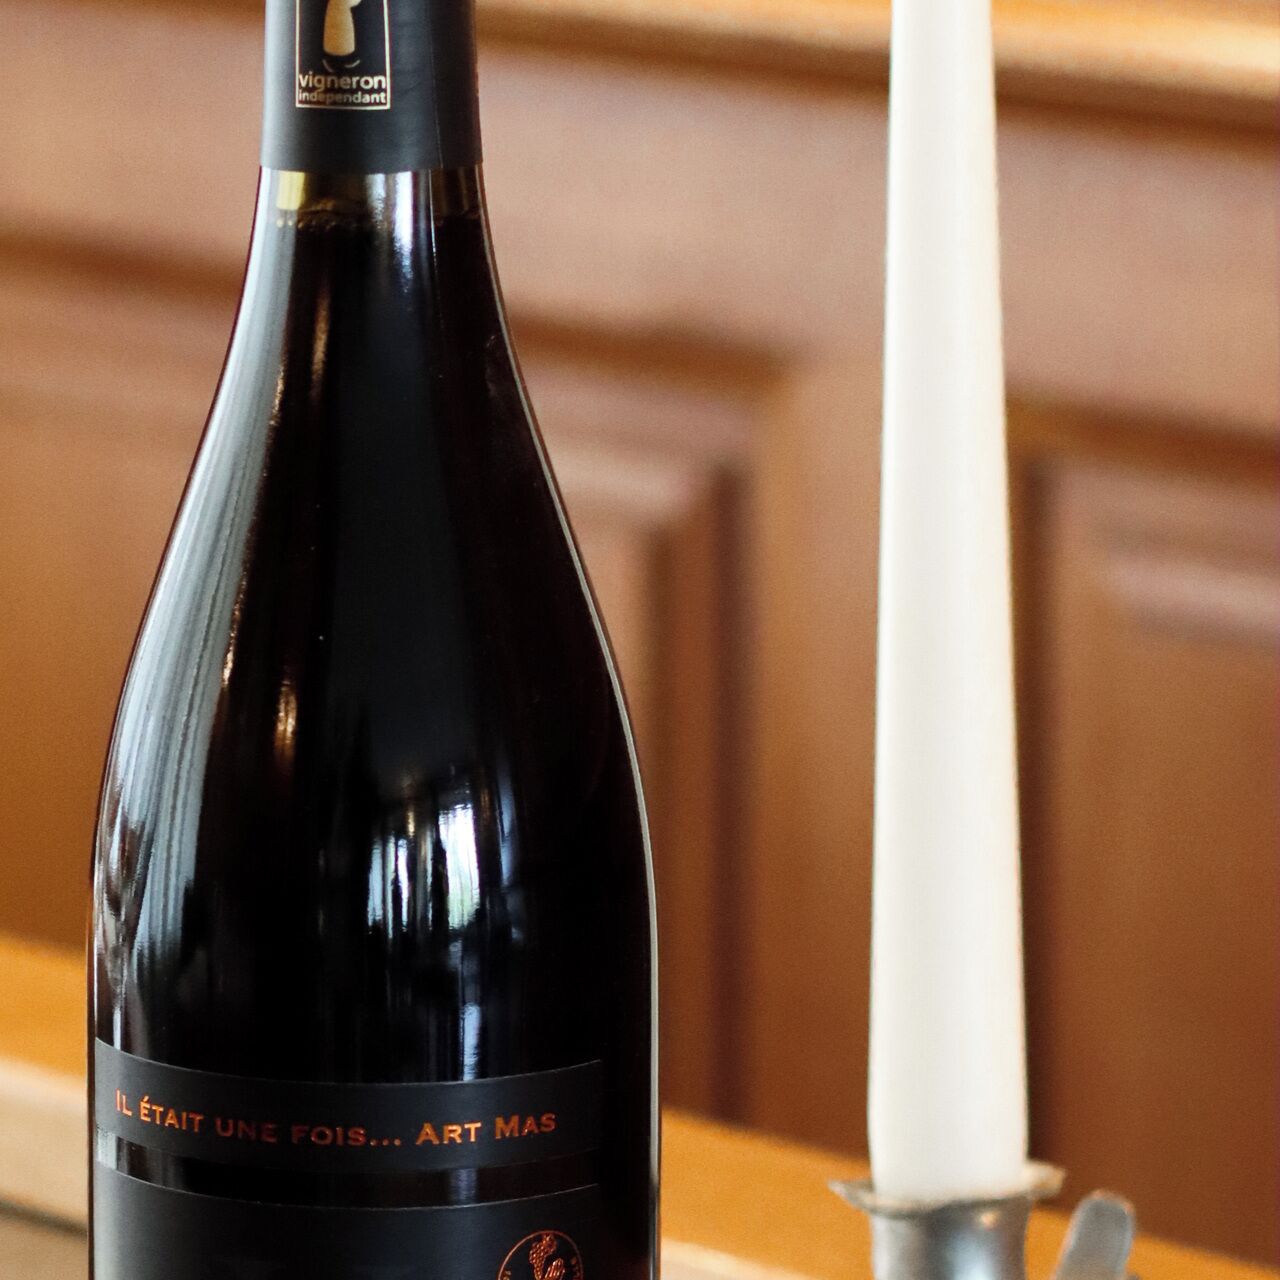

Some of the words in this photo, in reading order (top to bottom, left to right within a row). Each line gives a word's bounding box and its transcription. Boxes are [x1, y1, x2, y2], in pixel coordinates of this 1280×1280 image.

[298, 71, 387, 92] vigneron
[116, 1088, 133, 1117] IL
[139, 1095, 205, 1133] ÉTAIT
[215, 1116, 278, 1144] UNE
[291, 1122, 402, 1148] FOIS...
[415, 1121, 482, 1146] ART
[494, 1111, 557, 1140] MAS
